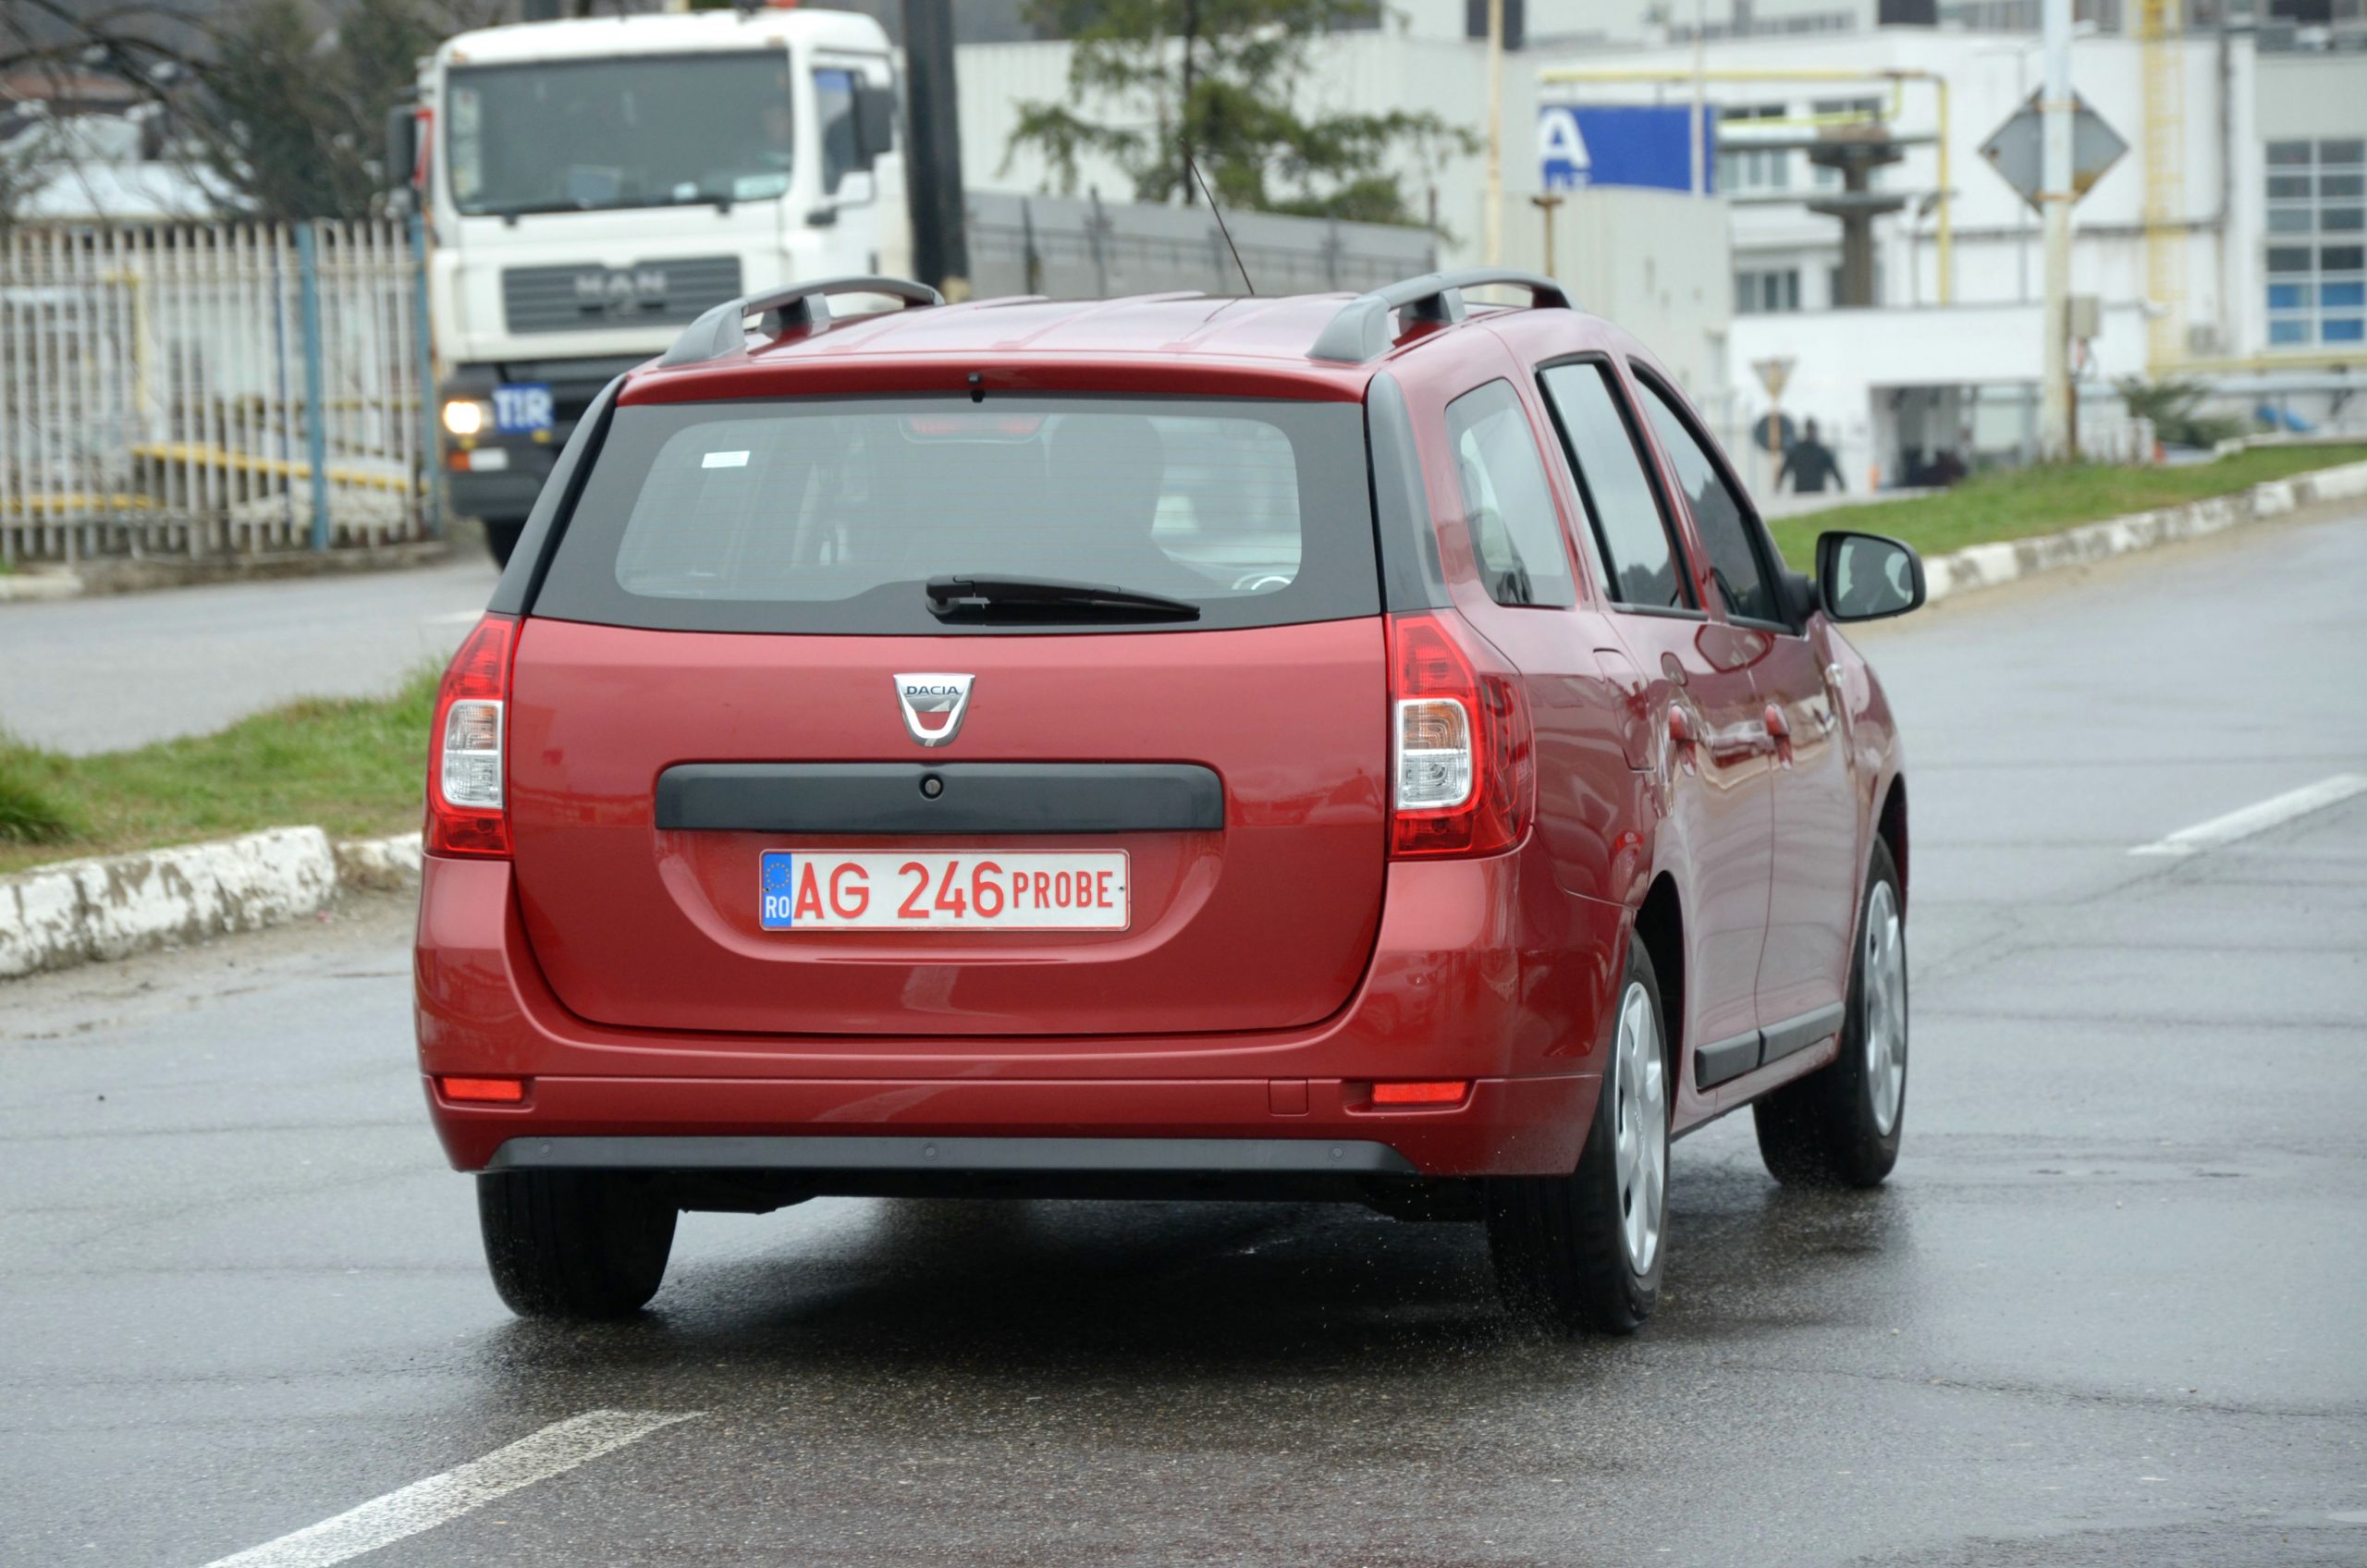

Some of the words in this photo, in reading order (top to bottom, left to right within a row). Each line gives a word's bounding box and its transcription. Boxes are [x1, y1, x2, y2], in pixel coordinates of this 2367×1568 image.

[574, 271, 668, 297] MAN
[492, 387, 553, 429] TIR
[906, 685, 959, 695] DACIA
[766, 895, 791, 919] RO
[793, 862, 870, 919] AG
[897, 861, 1005, 918] 246
[1012, 871, 1113, 909] PROBE
